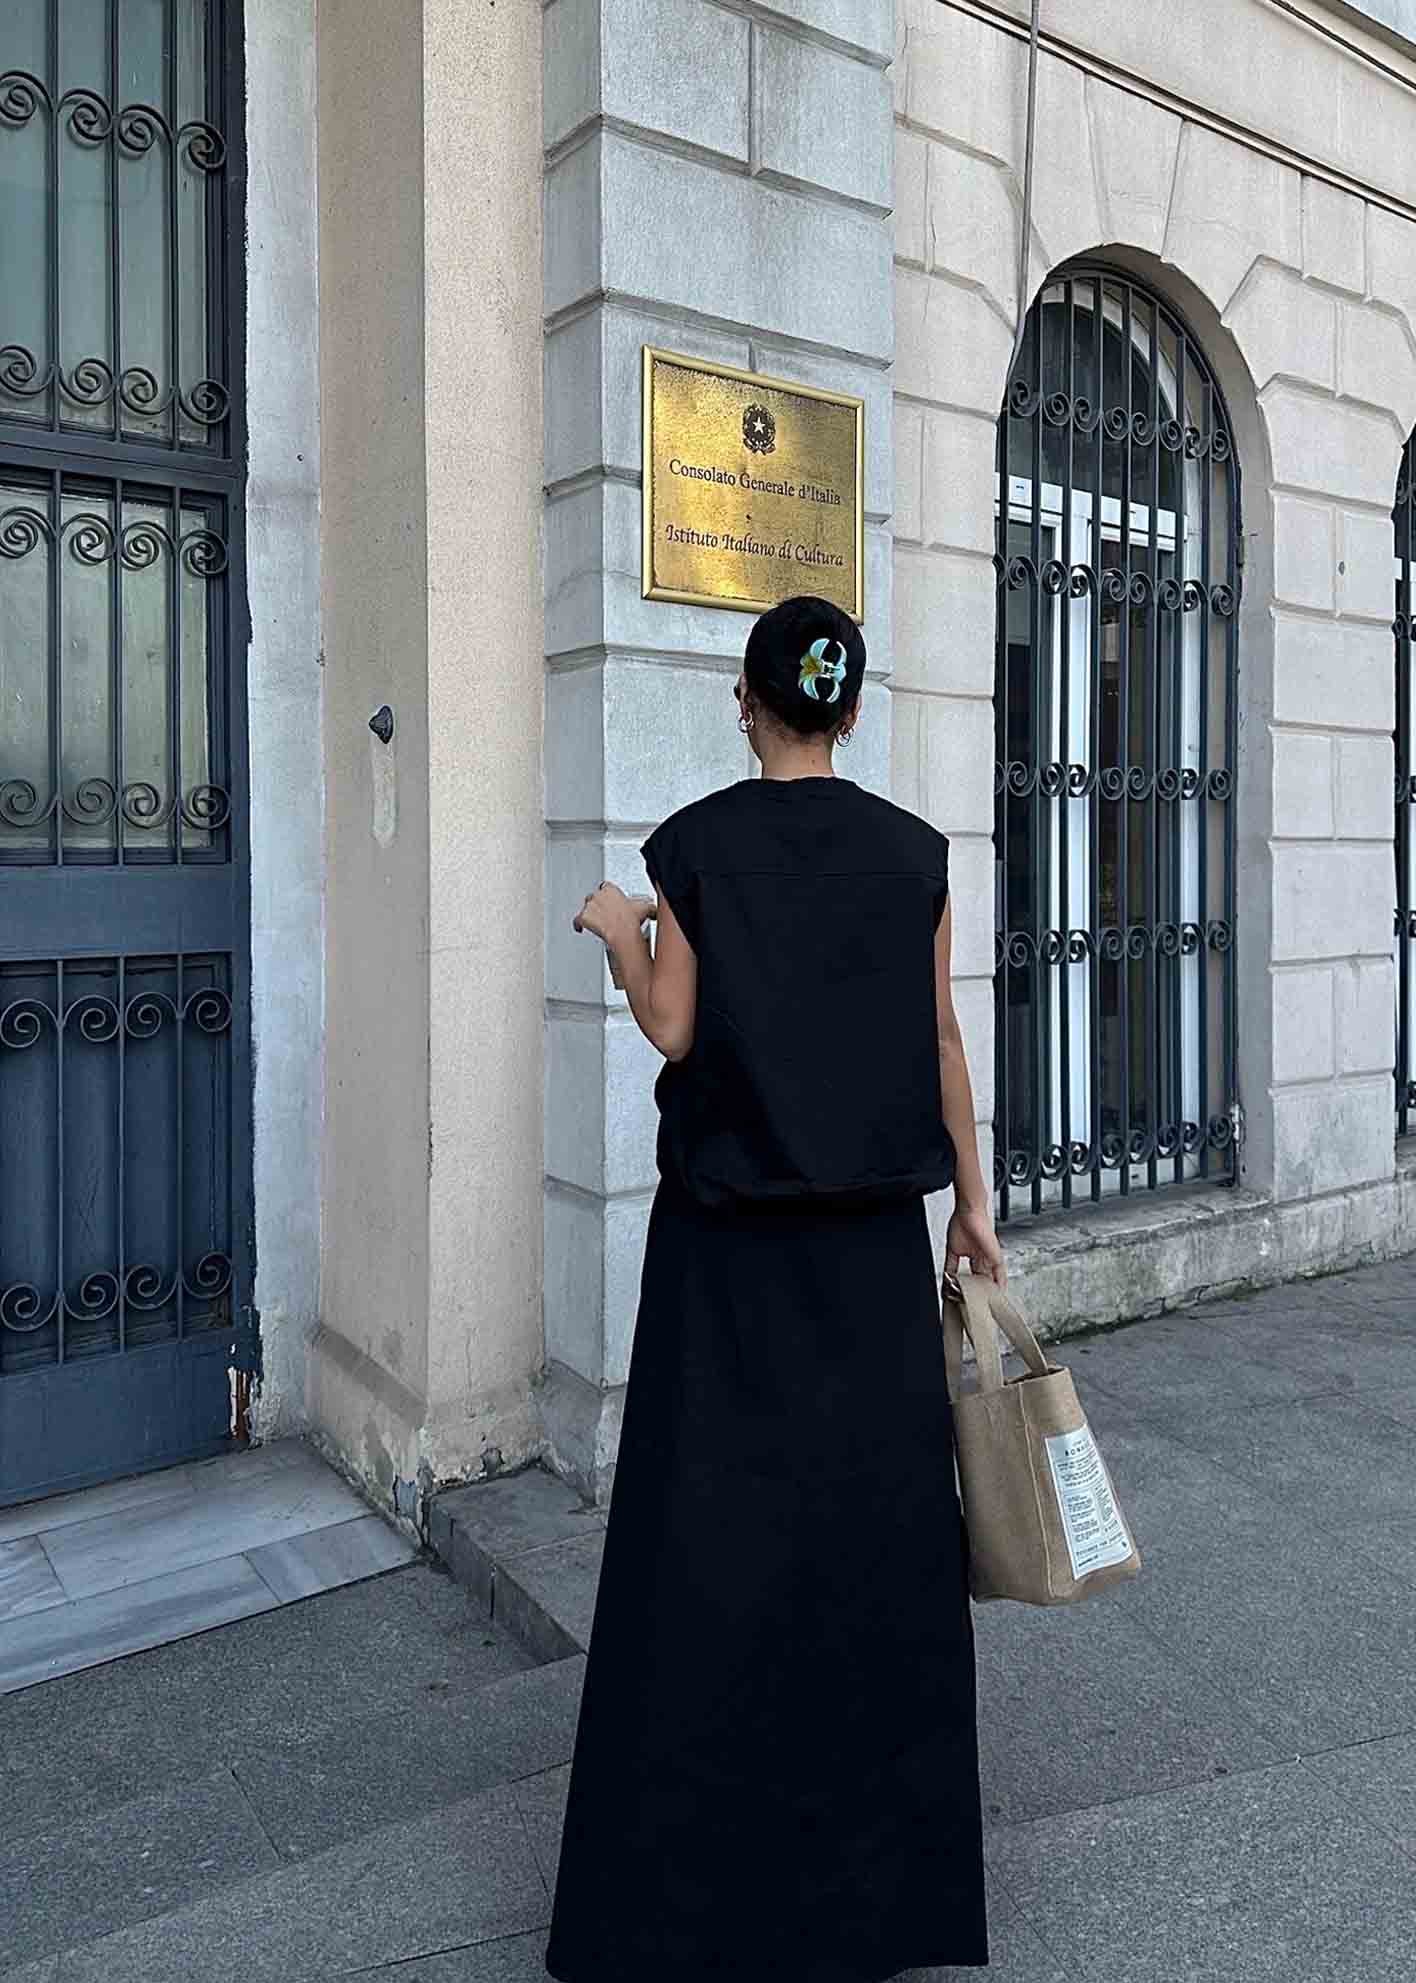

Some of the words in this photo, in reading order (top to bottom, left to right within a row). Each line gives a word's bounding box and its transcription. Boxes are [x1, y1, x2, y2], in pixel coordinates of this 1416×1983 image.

[669, 459, 736, 486] Consolato
[739, 472, 795, 497] Generale
[666, 524, 718, 548] Istituto
[722, 533, 775, 558] Italiano
[778, 540, 791, 560] di
[795, 543, 843, 567] Cultura
